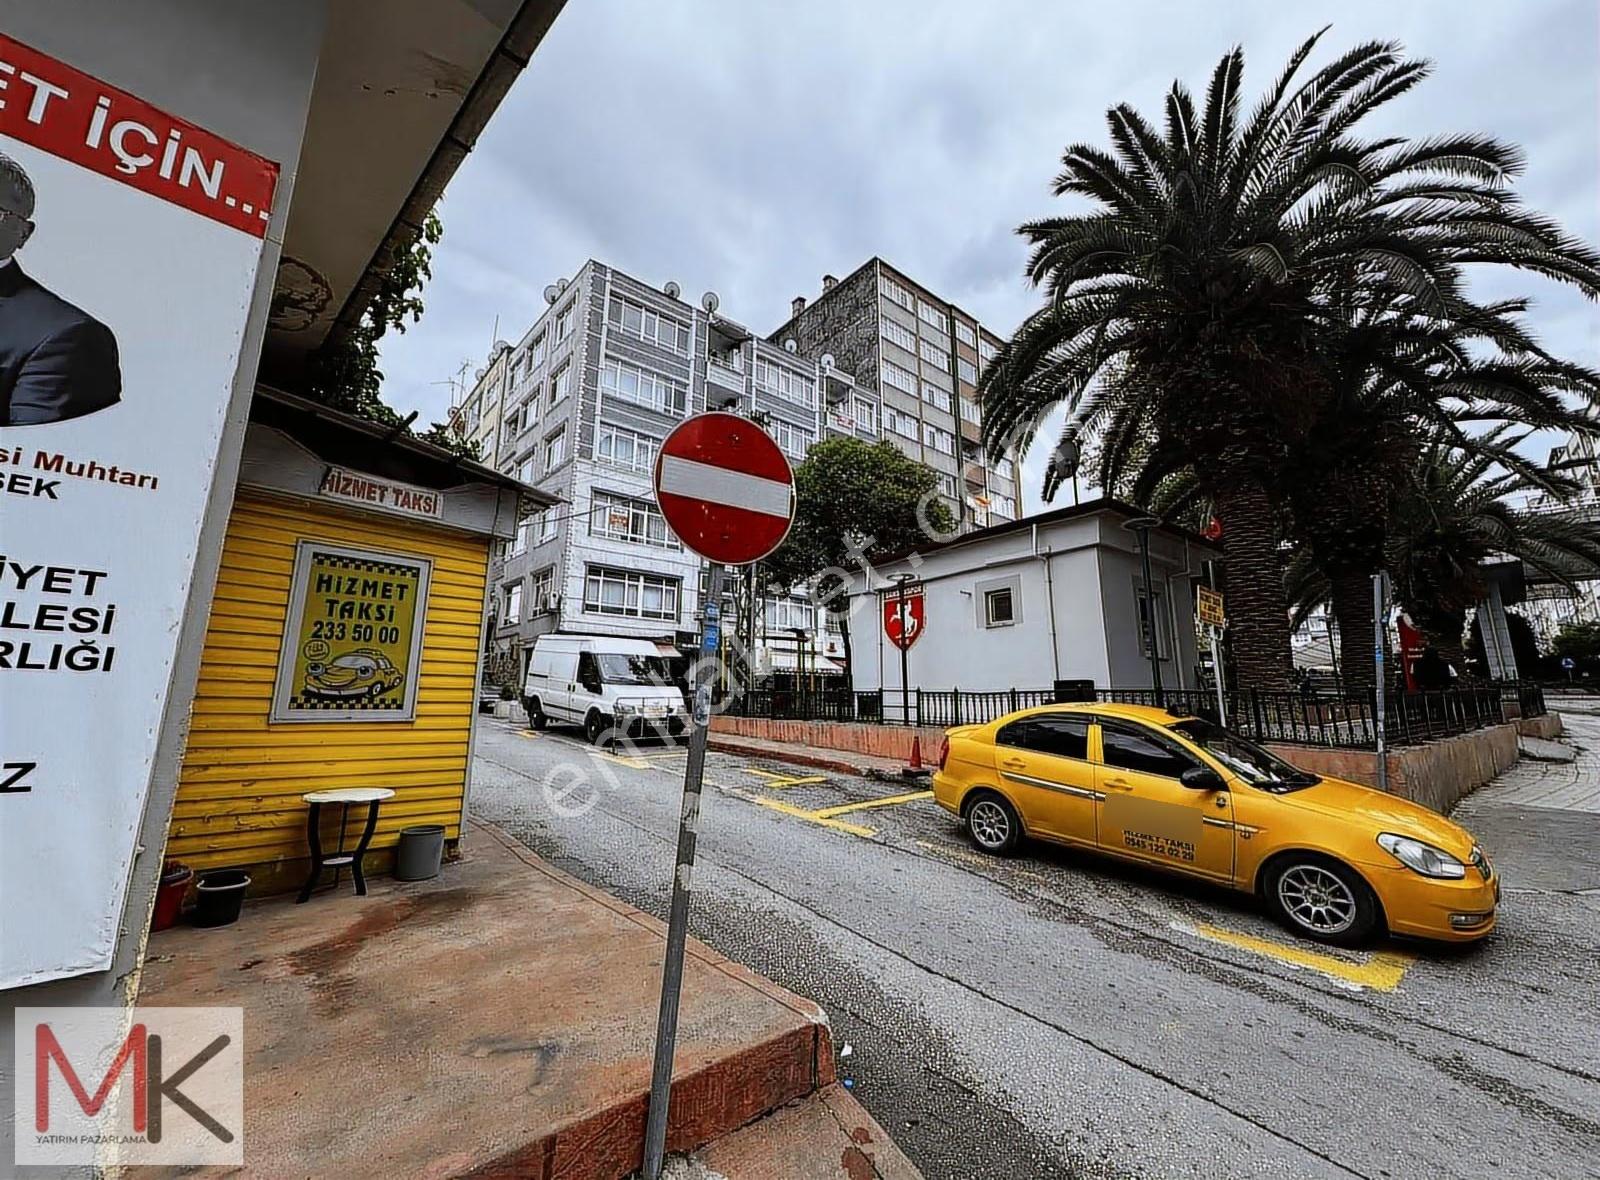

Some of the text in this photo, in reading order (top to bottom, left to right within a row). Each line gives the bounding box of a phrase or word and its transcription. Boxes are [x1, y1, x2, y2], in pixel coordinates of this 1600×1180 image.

[0, 471, 62, 499] EK
[33, 450, 159, 490] Muhtarı
[322, 468, 439, 515] HİZMET TAKSİ
[0, 602, 116, 635] LESİ
[311, 620, 399, 644] 233 50 00
[0, 762, 37, 793] Z
